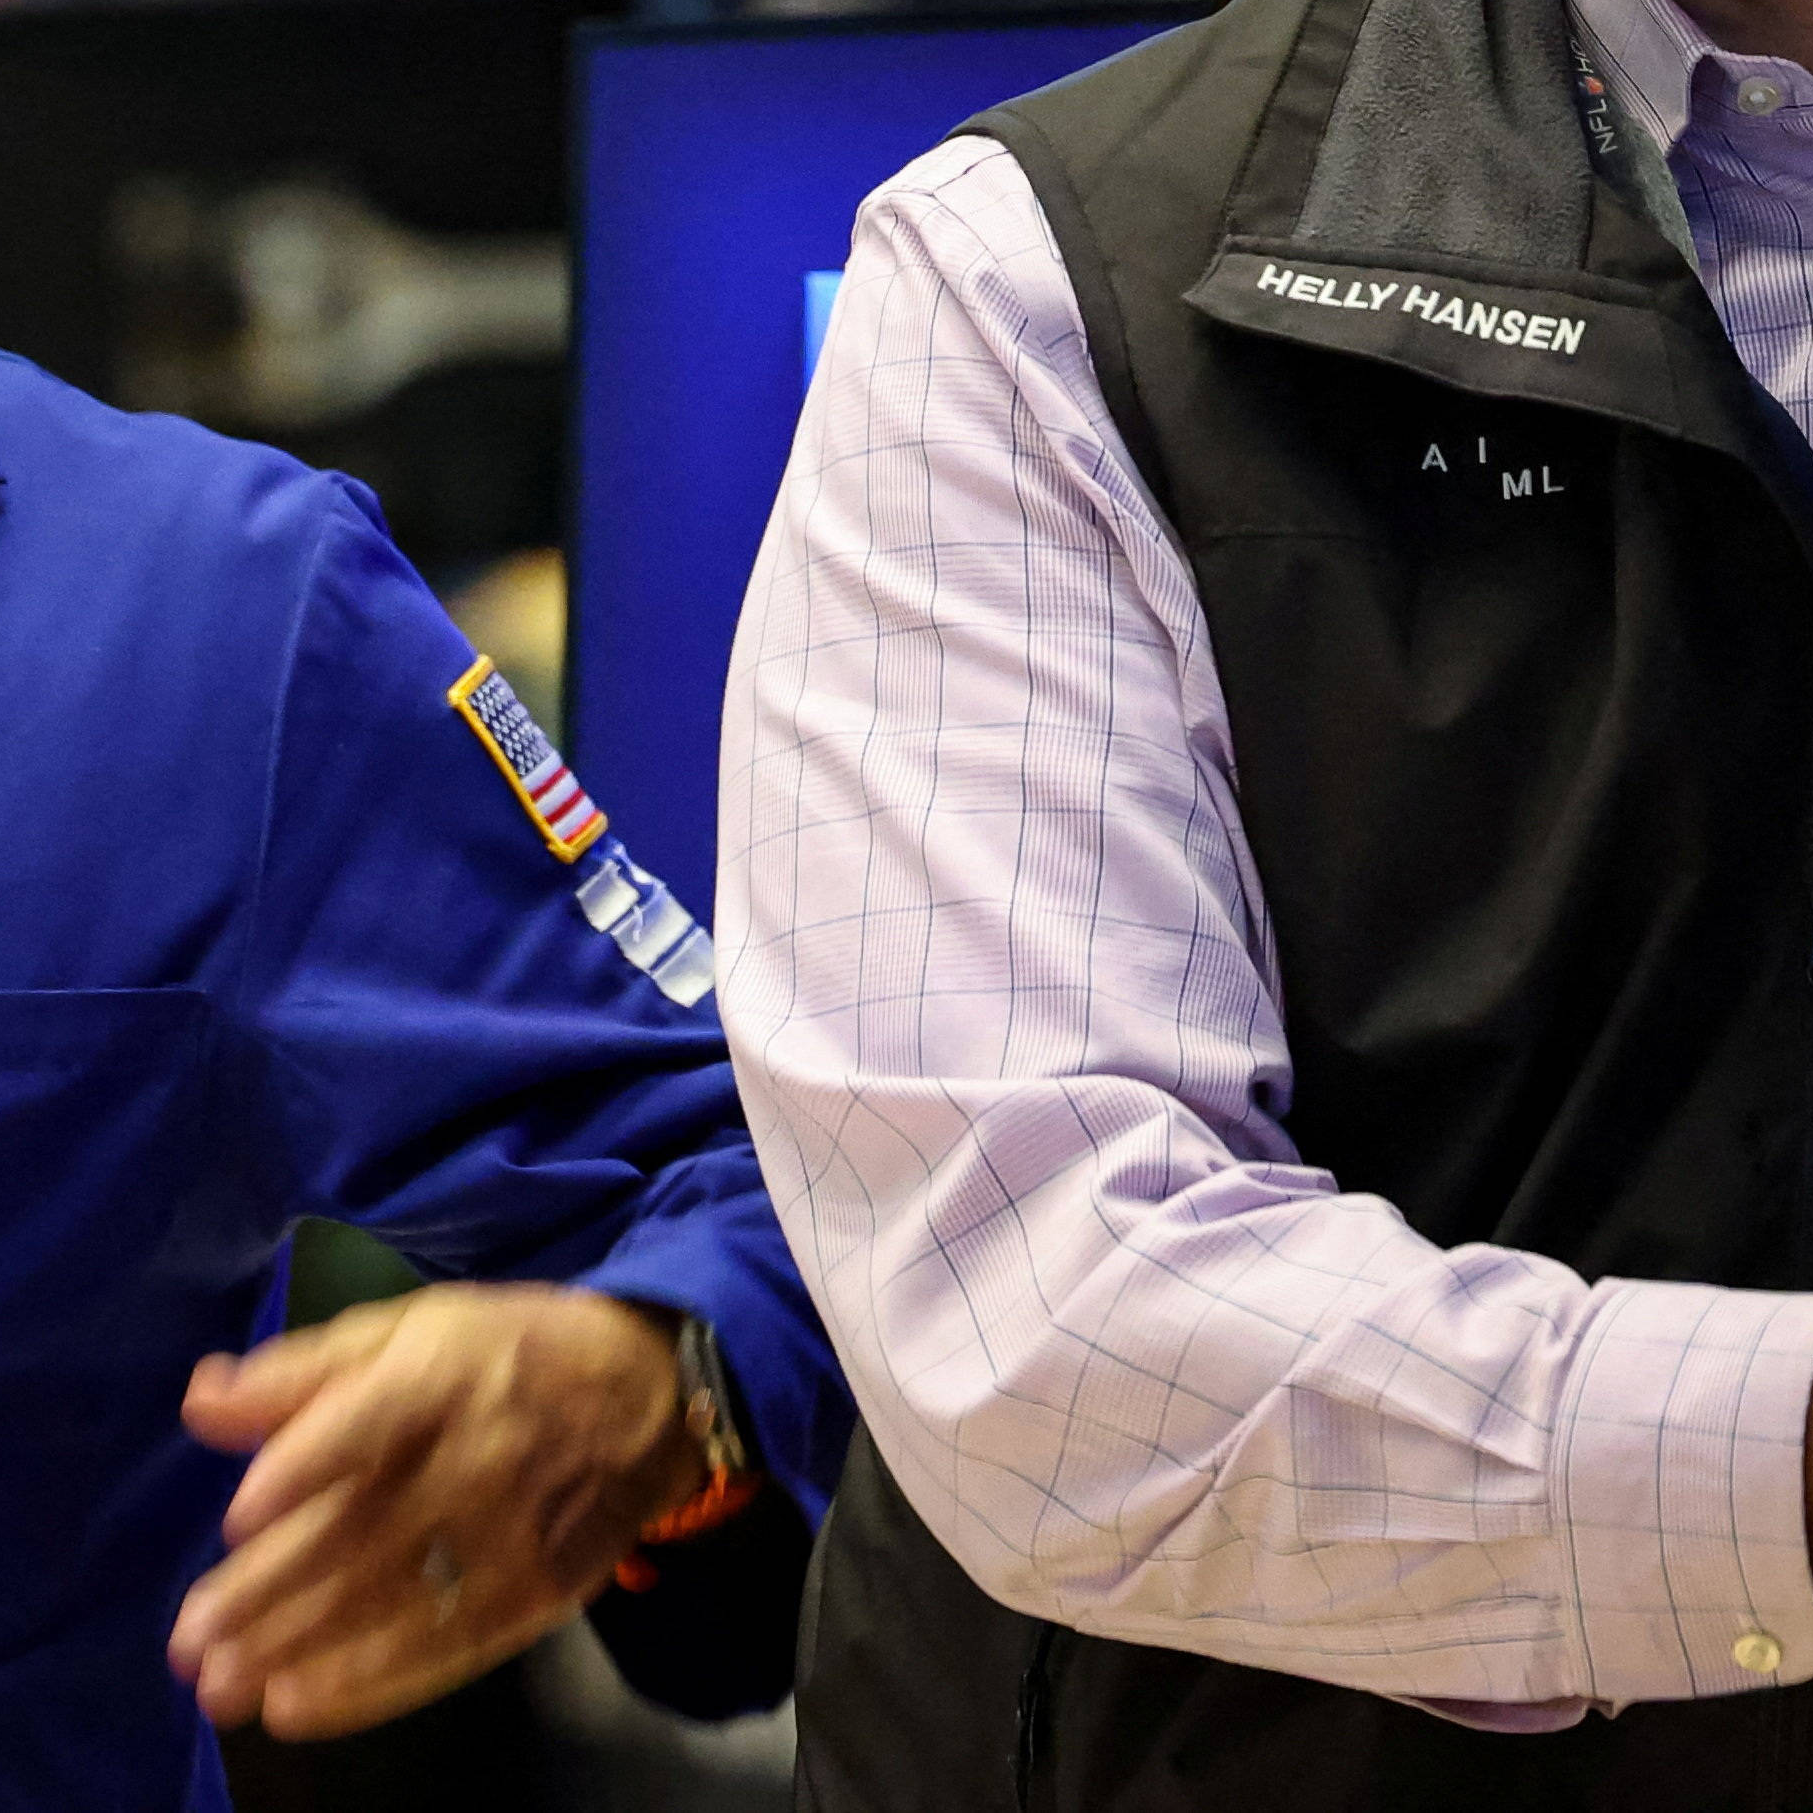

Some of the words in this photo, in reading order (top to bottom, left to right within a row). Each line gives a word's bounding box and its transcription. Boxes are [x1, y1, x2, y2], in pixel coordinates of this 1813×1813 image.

[1587, 98, 1618, 154] NFL
[1257, 264, 1399, 310] HELLY
[1401, 285, 1586, 355] HANSEN
